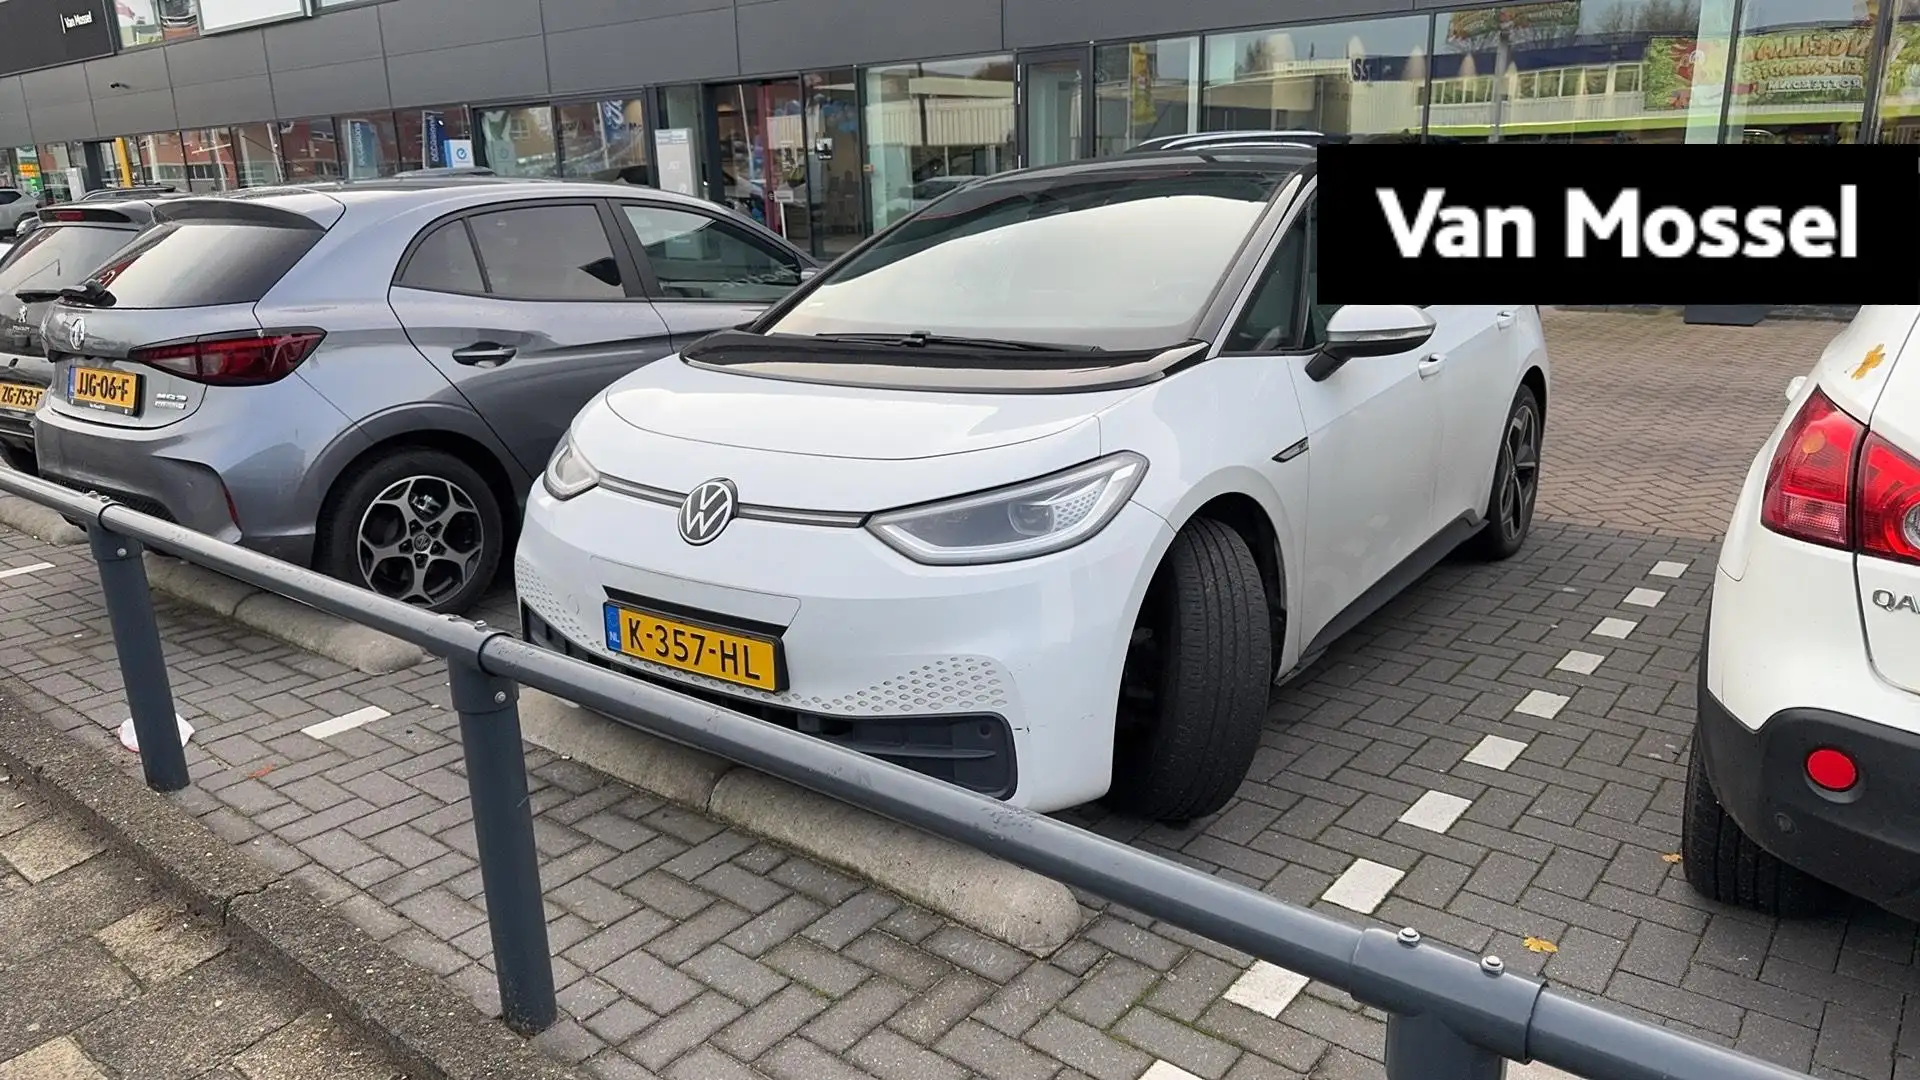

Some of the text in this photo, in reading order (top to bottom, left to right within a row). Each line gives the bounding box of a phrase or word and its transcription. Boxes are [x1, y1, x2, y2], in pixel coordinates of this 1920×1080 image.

[64, 10, 93, 28] Van Mossel
[77, 372, 130, 402] JJG-06-F
[1872, 588, 1920, 615] QA
[609, 631, 620, 643] NL
[628, 617, 761, 681] K-357-HL
